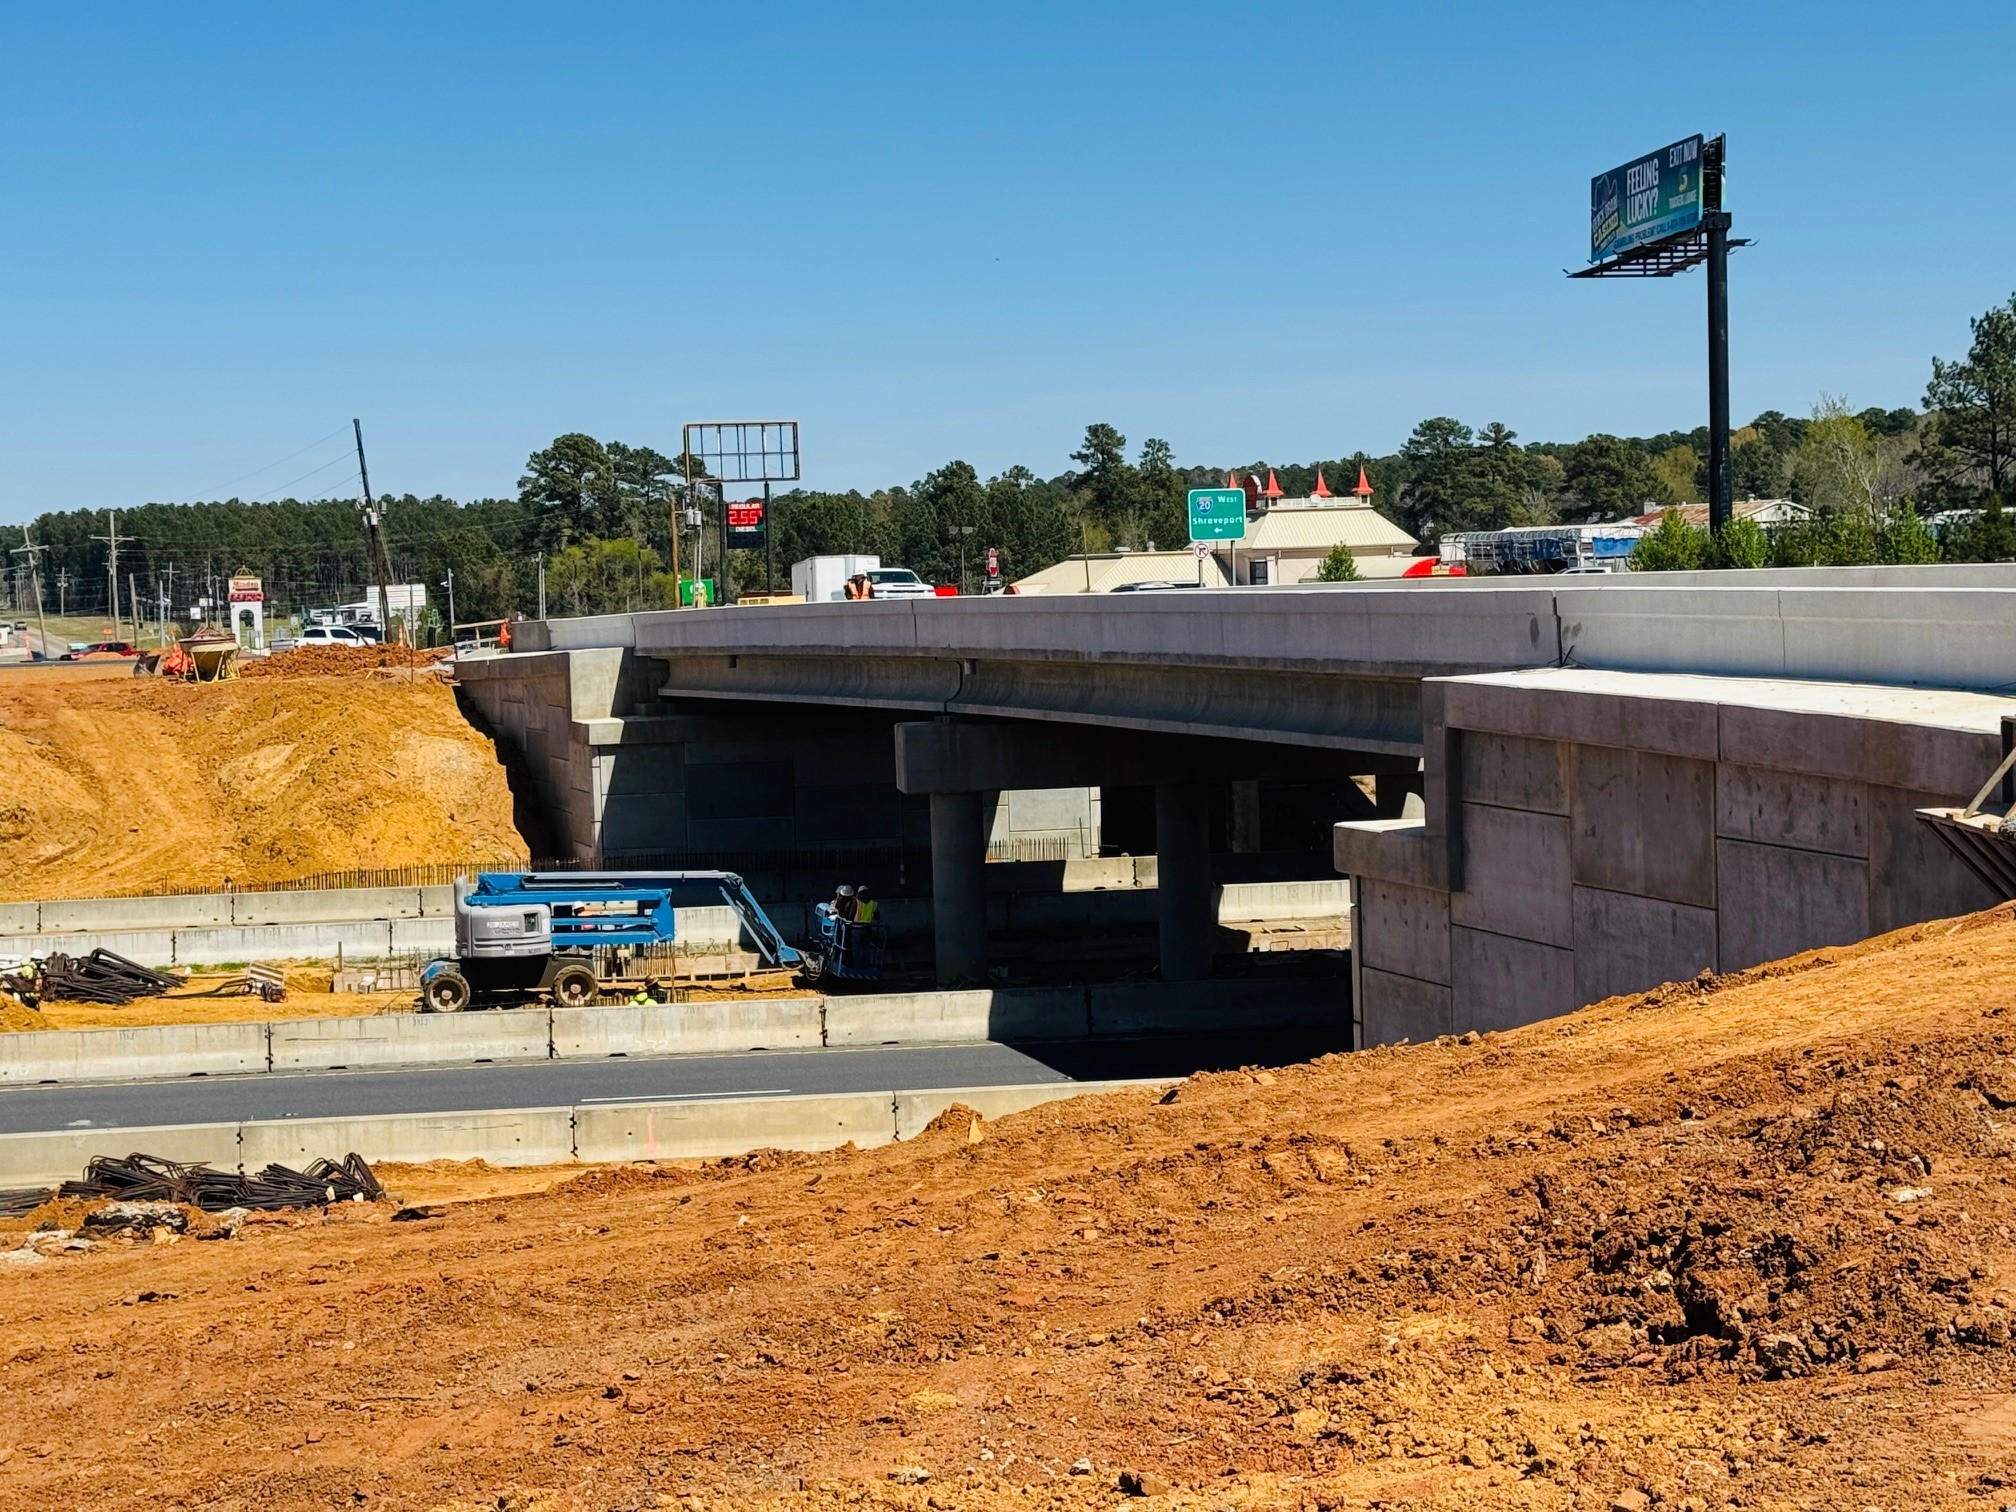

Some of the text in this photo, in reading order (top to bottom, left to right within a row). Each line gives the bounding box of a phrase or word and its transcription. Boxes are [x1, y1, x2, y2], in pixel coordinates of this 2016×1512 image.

[1669, 138, 1698, 168] EXIT NOW
[1627, 158, 1659, 196] FEELING
[1627, 187, 1659, 225] LUCKY?
[1198, 501, 1211, 510] 20
[1192, 516, 1243, 526] Shreveport
